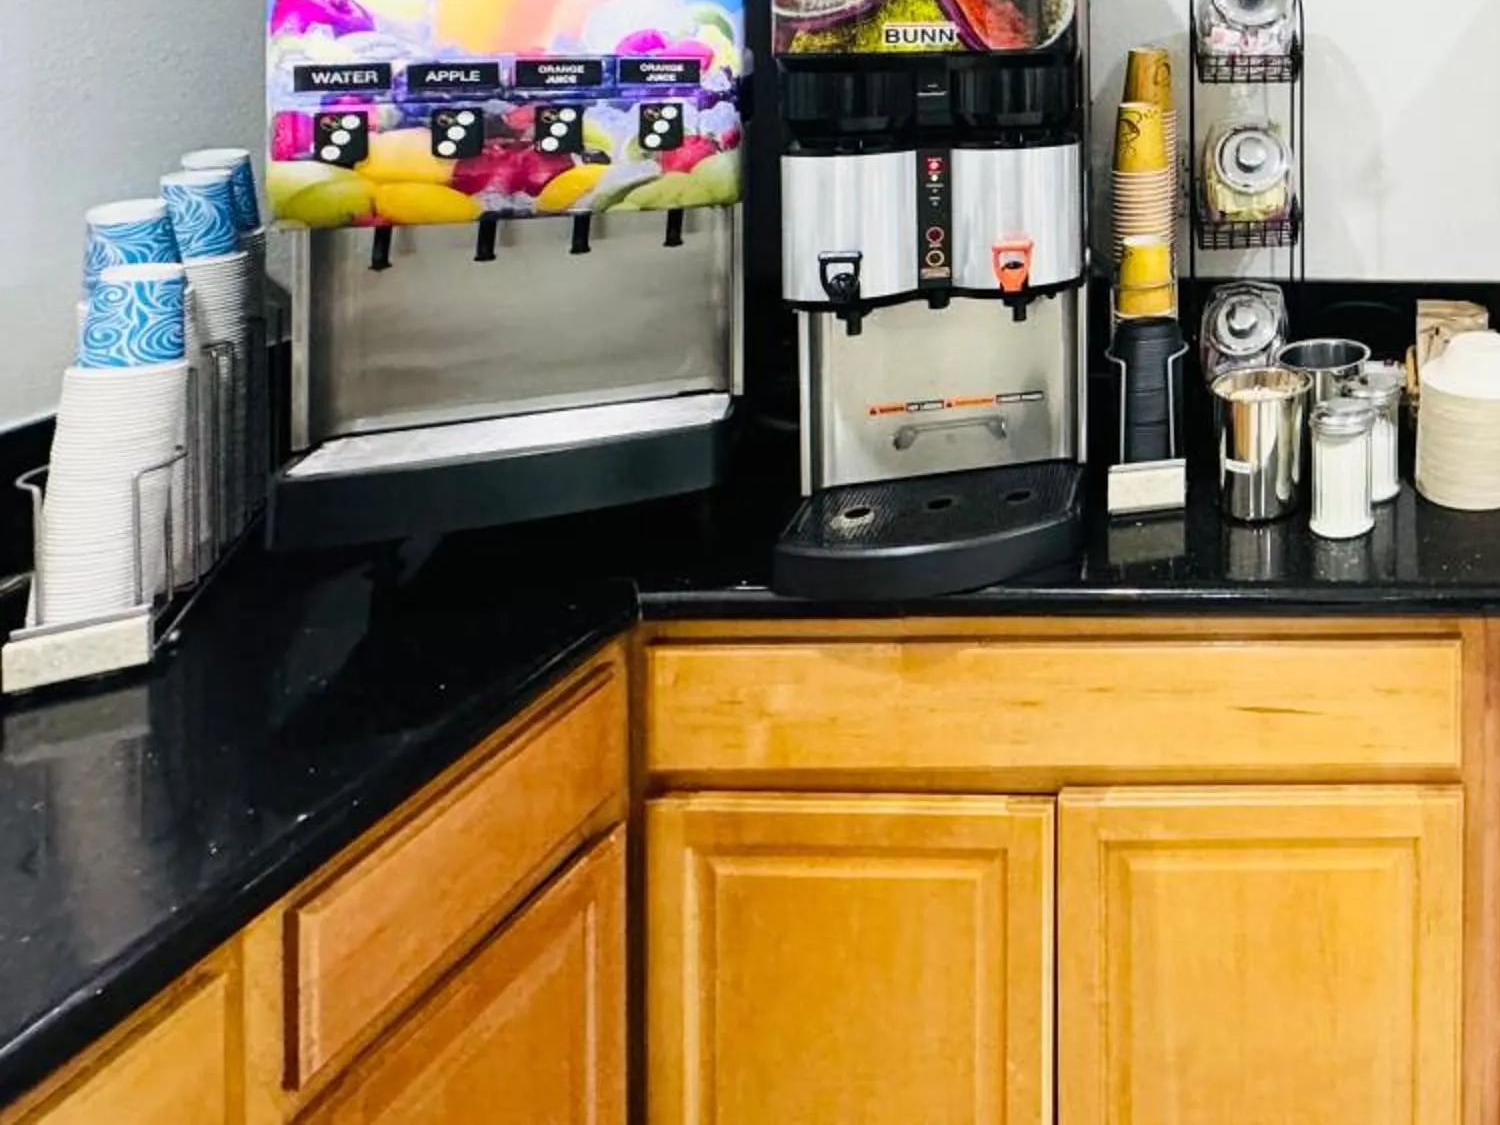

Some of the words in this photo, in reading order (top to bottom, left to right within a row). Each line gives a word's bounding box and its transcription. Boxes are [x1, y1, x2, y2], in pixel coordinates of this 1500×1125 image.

[885, 27, 954, 44] BUNN
[537, 64, 585, 74] ORANGE
[311, 70, 379, 85] WATER
[425, 70, 481, 83] APPLE
